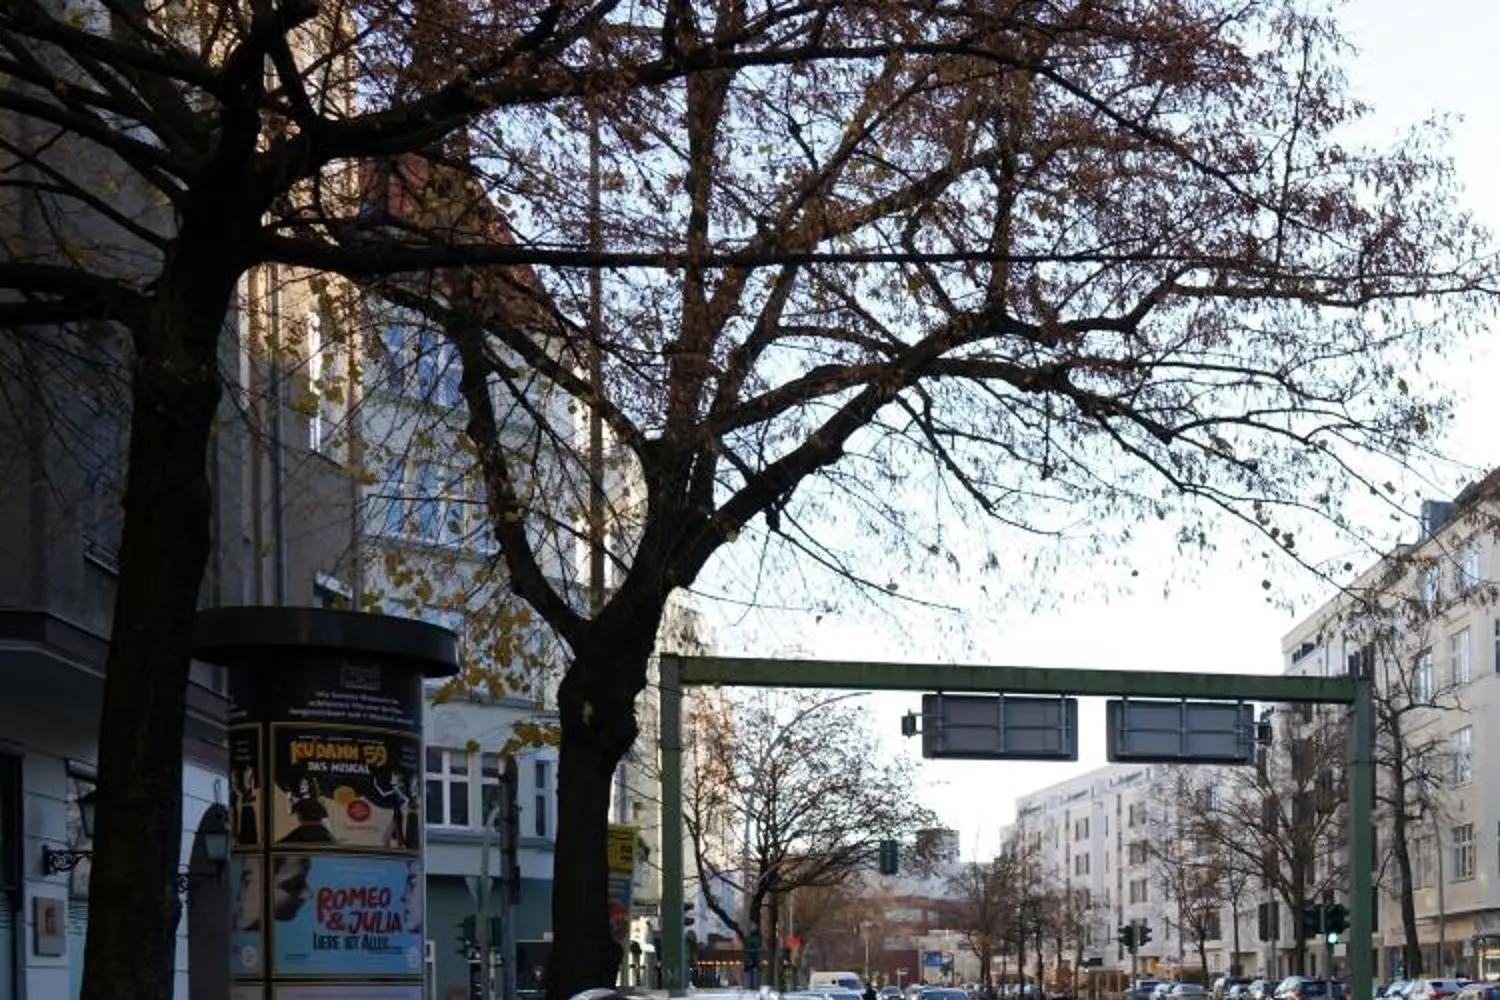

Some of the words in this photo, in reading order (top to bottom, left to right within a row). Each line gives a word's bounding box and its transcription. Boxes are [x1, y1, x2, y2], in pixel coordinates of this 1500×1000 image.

[331, 762, 371, 774] MUSICAL
[317, 886, 392, 923] ROMEO
[326, 912, 346, 931] &
[348, 910, 404, 934] JULIA
